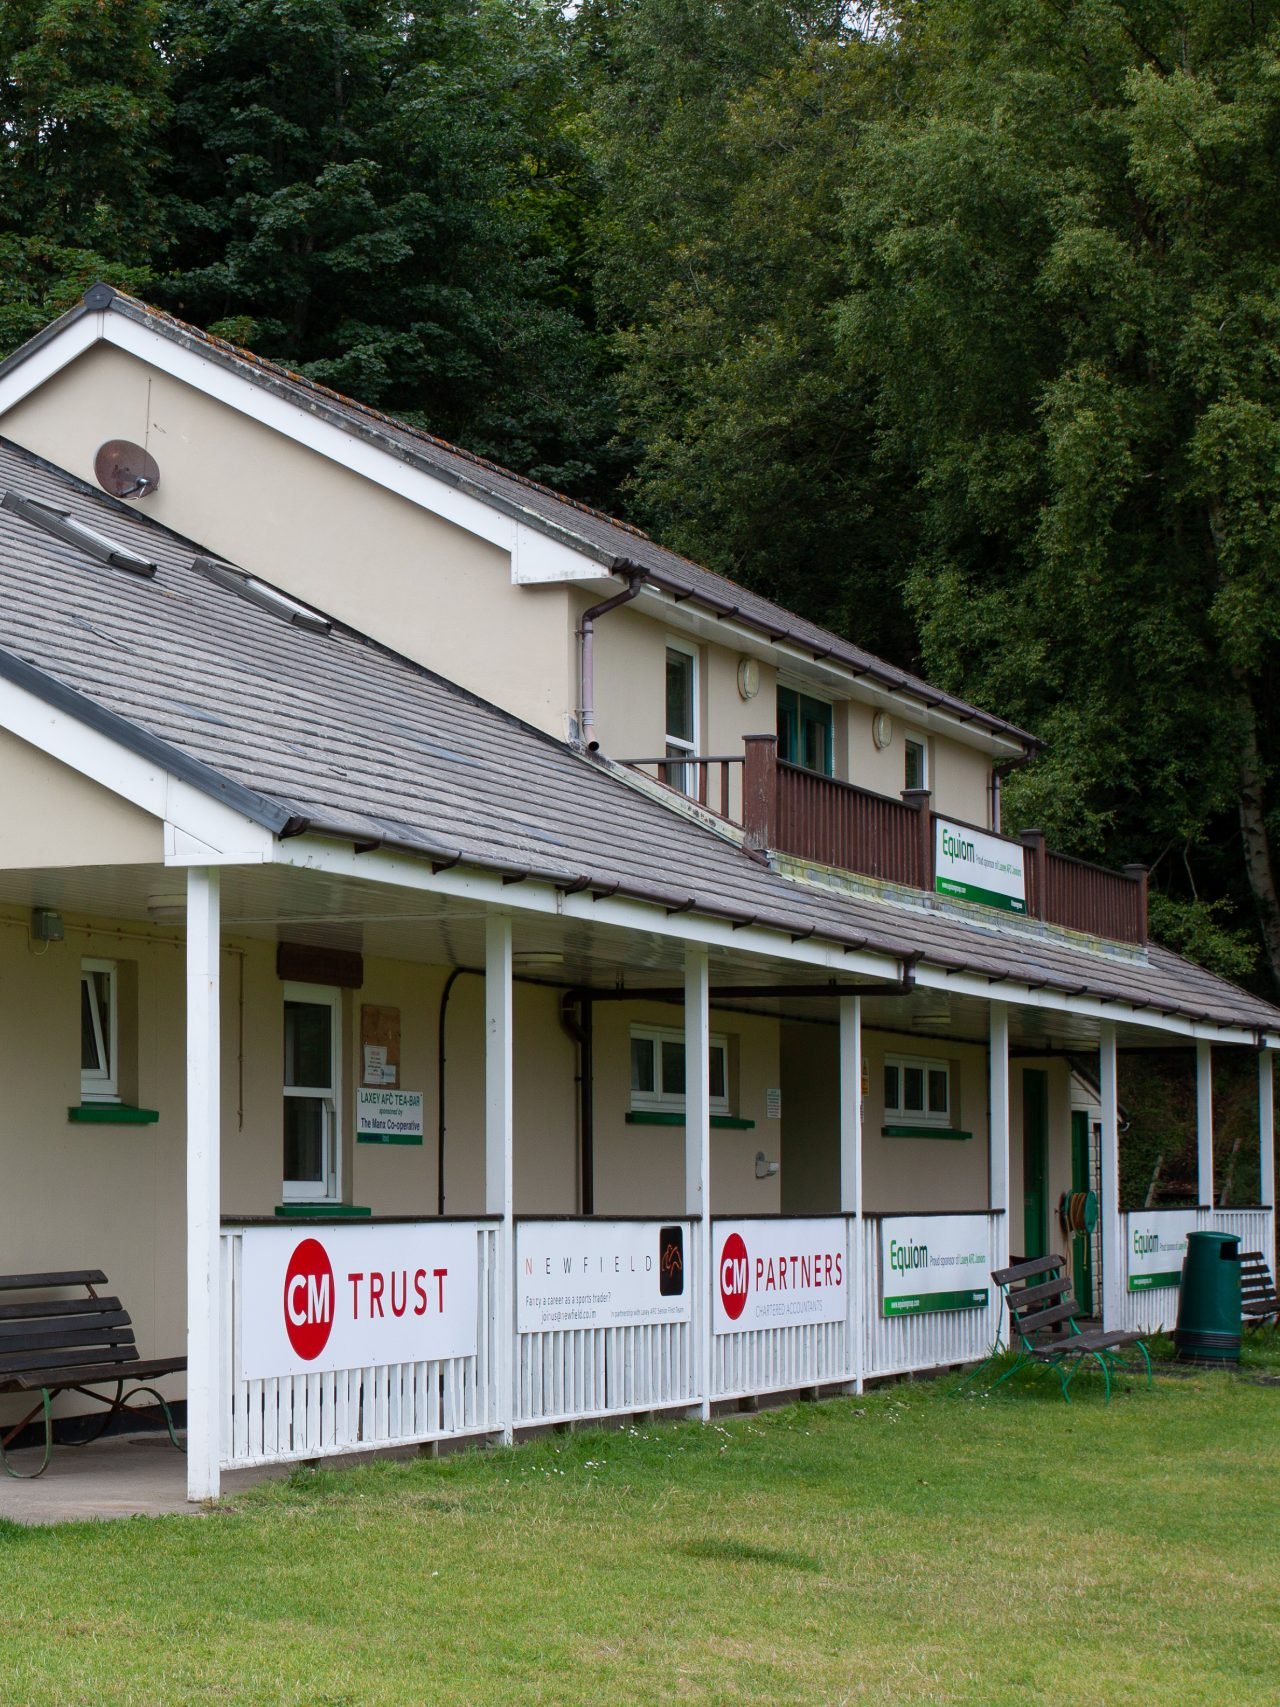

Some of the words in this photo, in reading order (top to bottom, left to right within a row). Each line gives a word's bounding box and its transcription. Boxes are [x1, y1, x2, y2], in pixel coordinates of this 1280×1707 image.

[943, 828, 975, 863] Equiom
[360, 1092, 381, 1104] LAXEY
[382, 1093, 394, 1105] AFC
[395, 1095, 420, 1107] TEA-BAR
[361, 1117, 371, 1128] The
[372, 1118, 386, 1129] Manx
[387, 1119, 420, 1132] Co-operative
[890, 1238, 928, 1277] Equiom
[1134, 1228, 1159, 1260] Equiom
[722, 1258, 746, 1295] CM
[756, 1253, 842, 1292] PARTNERS
[287, 1274, 330, 1326] CM
[348, 1268, 448, 1319] TRUST
[525, 1296, 542, 1308] Fancy
[543, 1297, 547, 1305] a
[547, 1296, 564, 1305] career
[565, 1296, 571, 1304] as
[572, 1296, 575, 1304] a
[576, 1293, 592, 1306] sports
[592, 1291, 612, 1303] trader?
[755, 1303, 785, 1318] CHARTERED
[787, 1299, 823, 1315] ACCOUNTANTS
